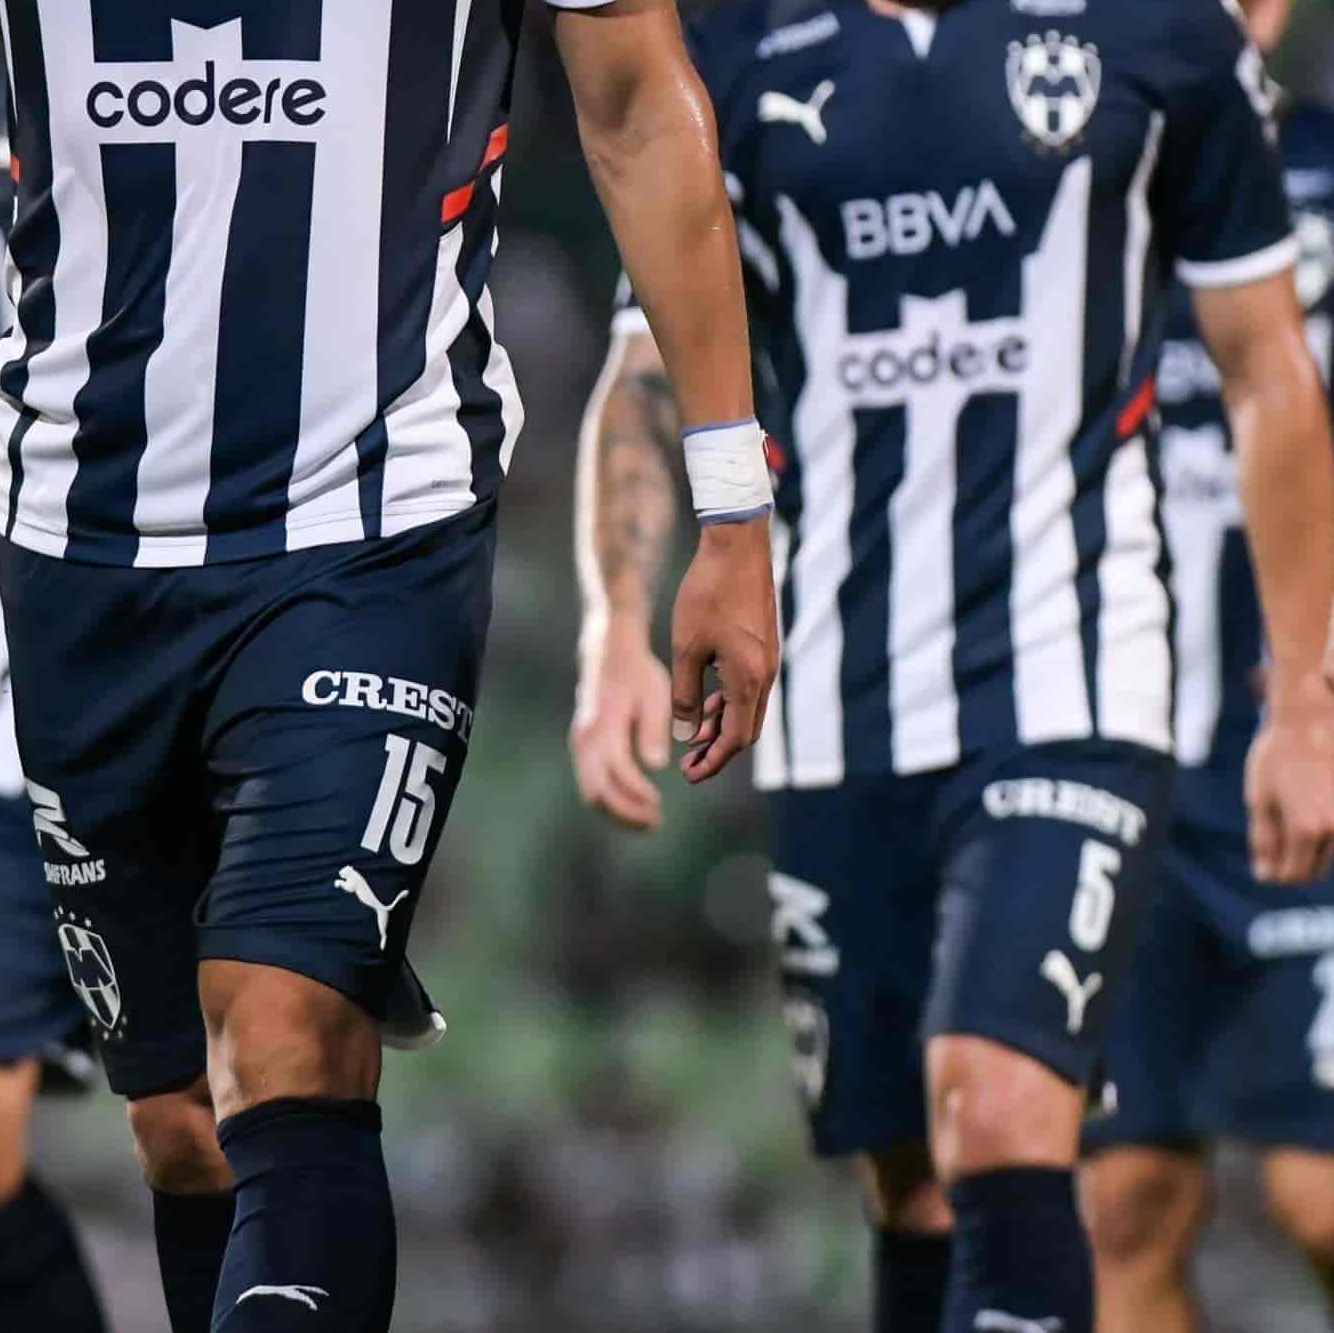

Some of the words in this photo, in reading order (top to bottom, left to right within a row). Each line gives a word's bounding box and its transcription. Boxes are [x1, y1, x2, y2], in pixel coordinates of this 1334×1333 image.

[86, 60, 327, 129] codere
[839, 178, 1017, 261] BBVA
[837, 327, 1030, 393] codee
[301, 669, 474, 744] CREST
[360, 732, 448, 866] 15
[1069, 837, 1122, 953] 5
